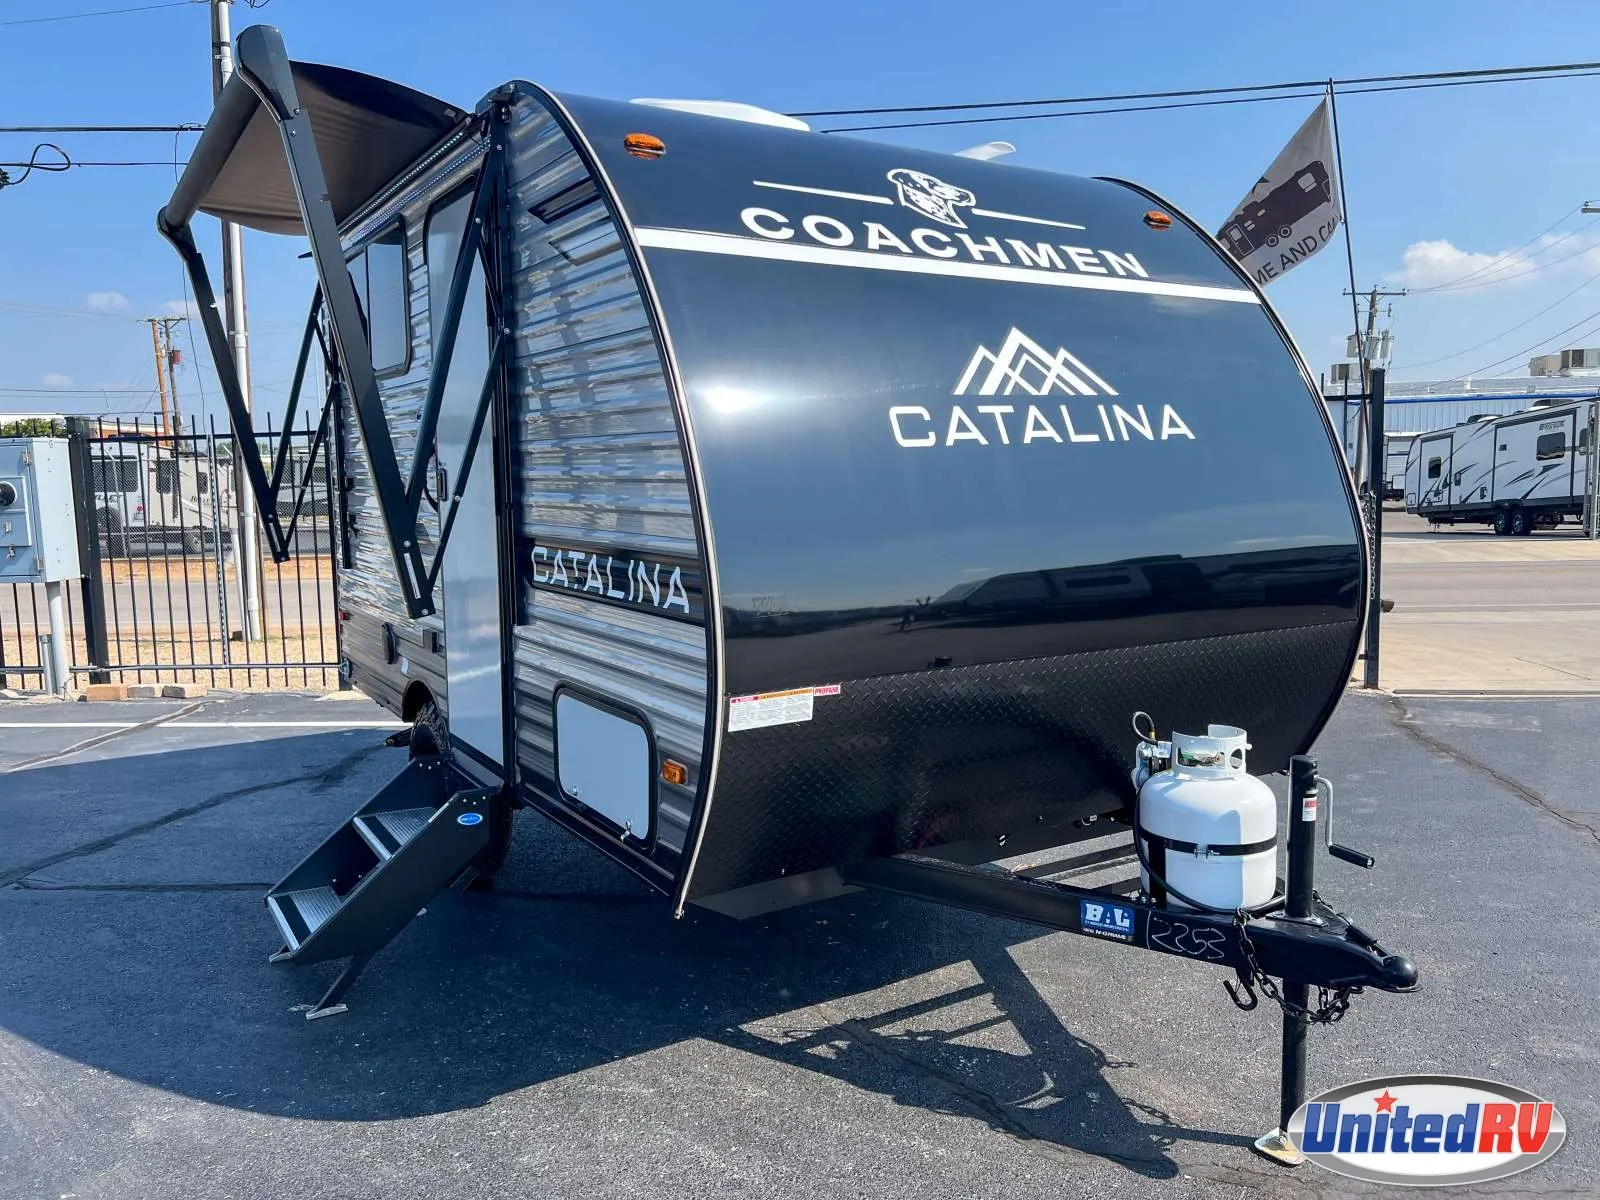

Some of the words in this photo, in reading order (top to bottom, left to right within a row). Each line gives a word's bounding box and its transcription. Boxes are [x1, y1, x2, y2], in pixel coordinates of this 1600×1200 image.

[740, 207, 1149, 278] COACHMEN
[1251, 261, 1279, 286] ME
[1280, 235, 1318, 271] AND
[889, 404, 1196, 447] CATALINA
[531, 546, 690, 614] CATALINA
[814, 685, 839, 694] PROPANE
